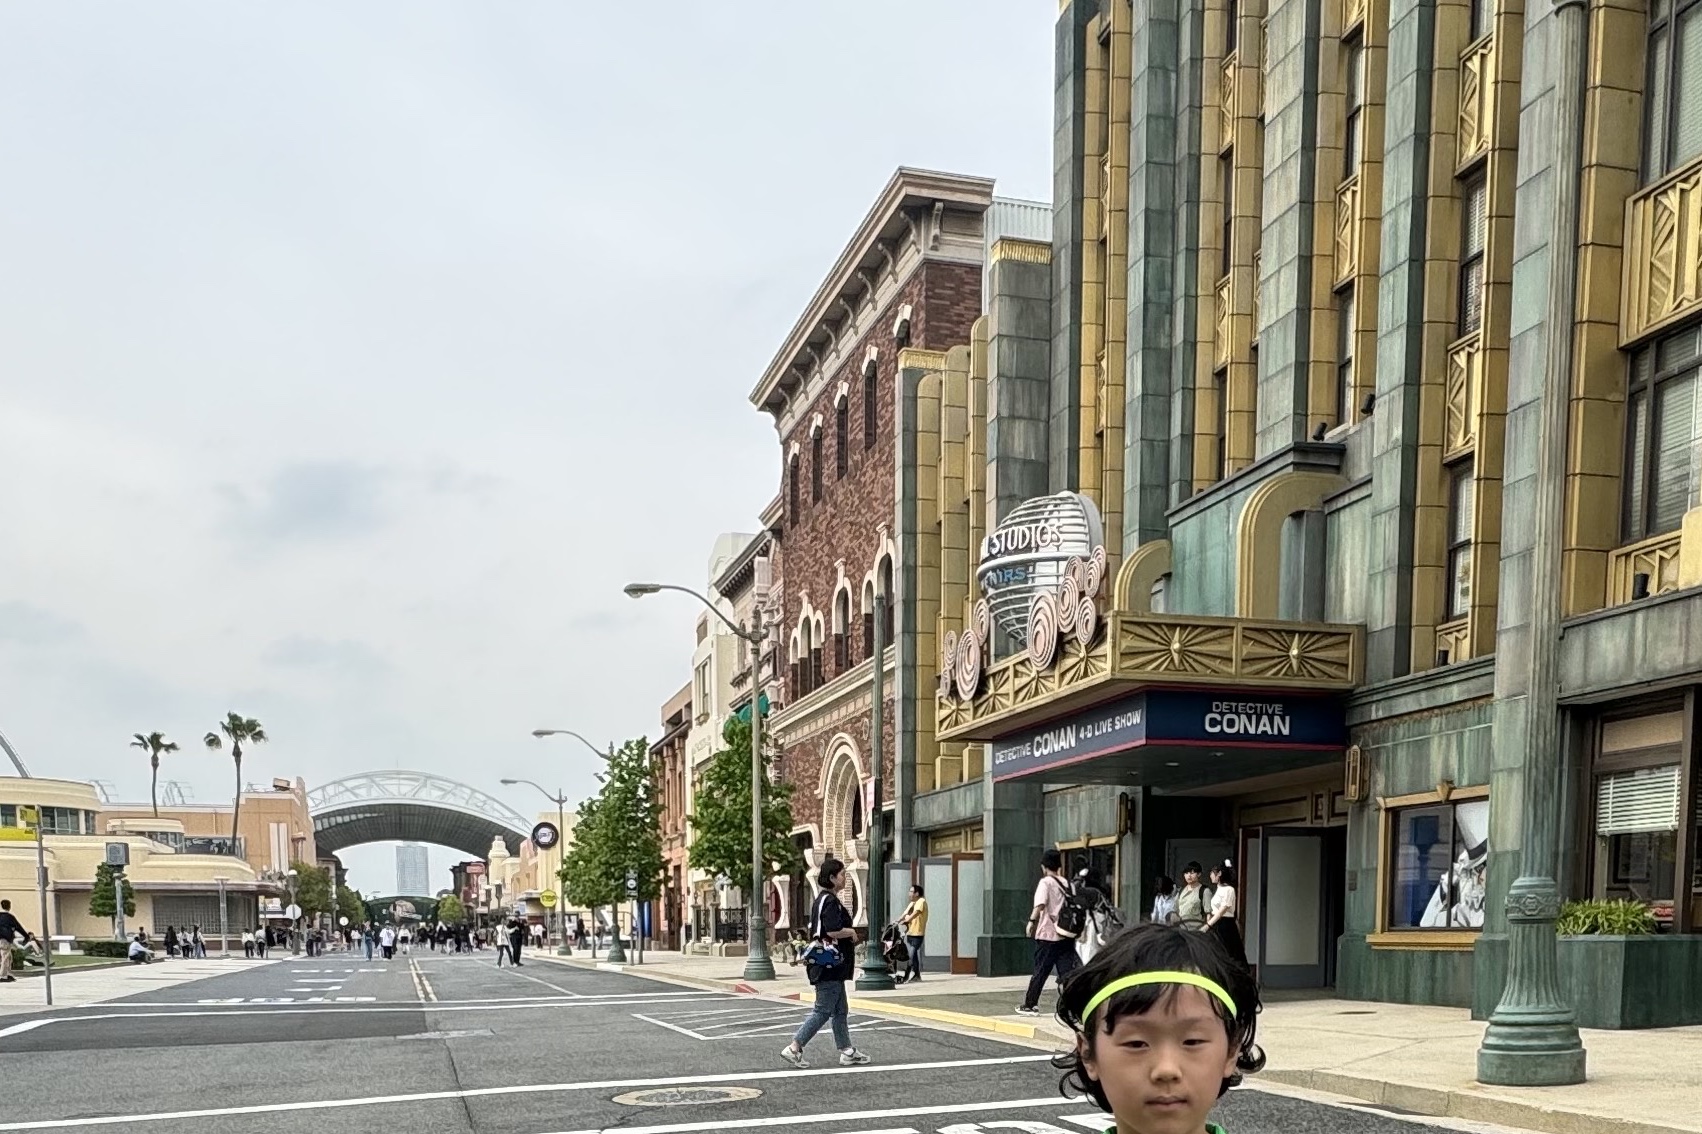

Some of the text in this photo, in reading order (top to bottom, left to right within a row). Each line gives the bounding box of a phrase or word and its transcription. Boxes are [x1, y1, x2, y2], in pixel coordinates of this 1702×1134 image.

[990, 521, 1064, 555] STUDIOS
[1212, 701, 1284, 715] DETECTIVE
[994, 709, 1143, 765] DETECTIVE CONAN 4-D LIVE SHOW
[1204, 712, 1290, 736] CONAN
